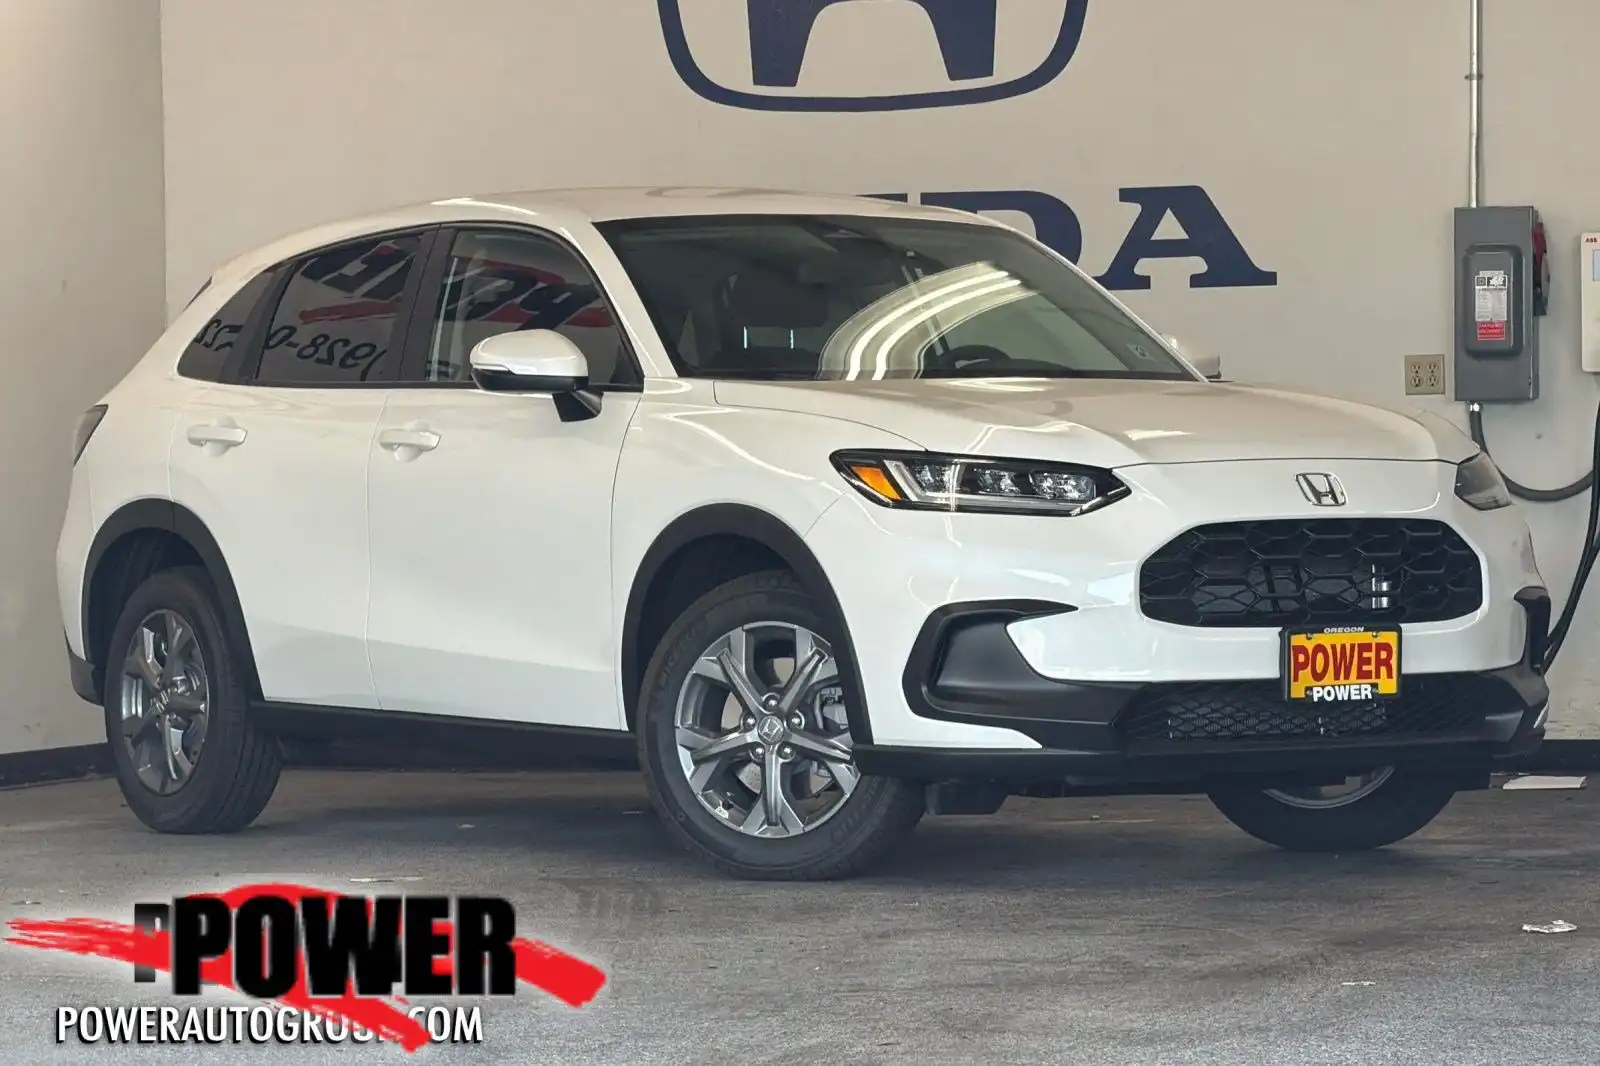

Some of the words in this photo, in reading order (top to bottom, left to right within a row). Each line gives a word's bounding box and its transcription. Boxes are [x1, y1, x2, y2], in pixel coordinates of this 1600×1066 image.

[857, 185, 1278, 291] DA
[1323, 626, 1365, 634] OREGON
[1291, 642, 1394, 683] POWER
[1312, 684, 1373, 702] POWER
